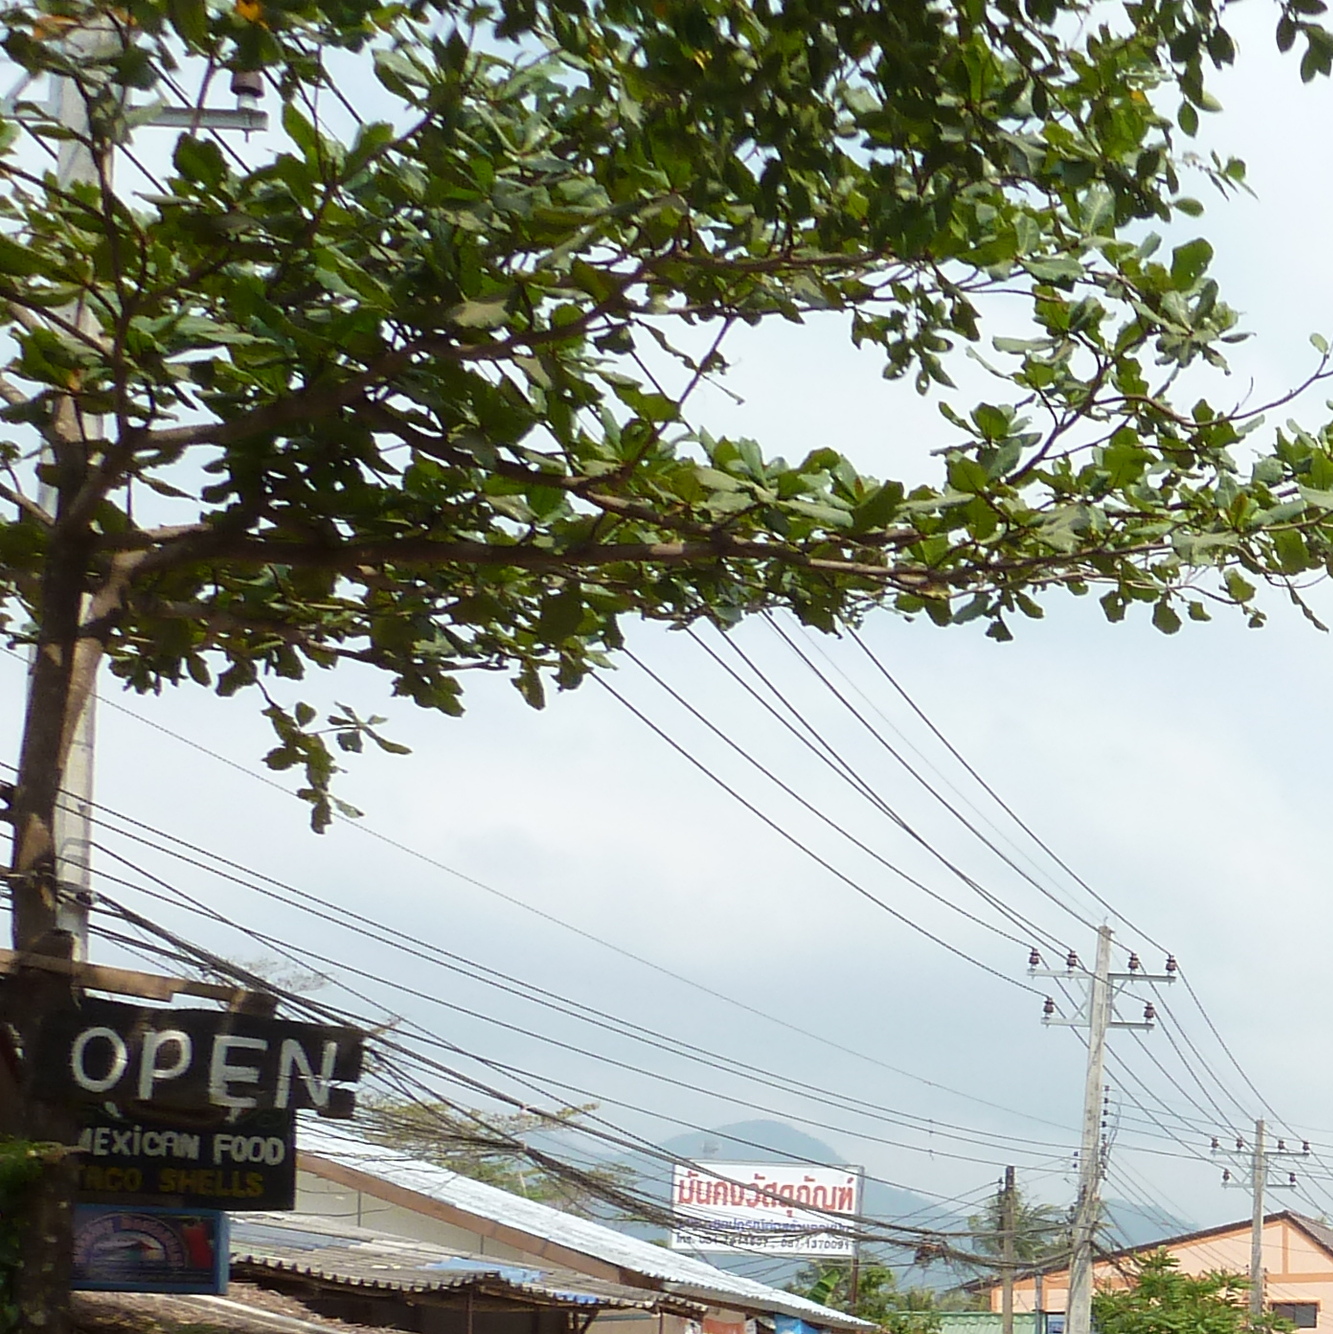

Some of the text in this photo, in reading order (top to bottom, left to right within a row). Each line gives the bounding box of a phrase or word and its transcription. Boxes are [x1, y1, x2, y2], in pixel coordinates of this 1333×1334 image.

[71, 1026, 338, 1109] OPEN
[212, 1133, 285, 1165] FOOD
[159, 1167, 264, 1197] SHELLS
